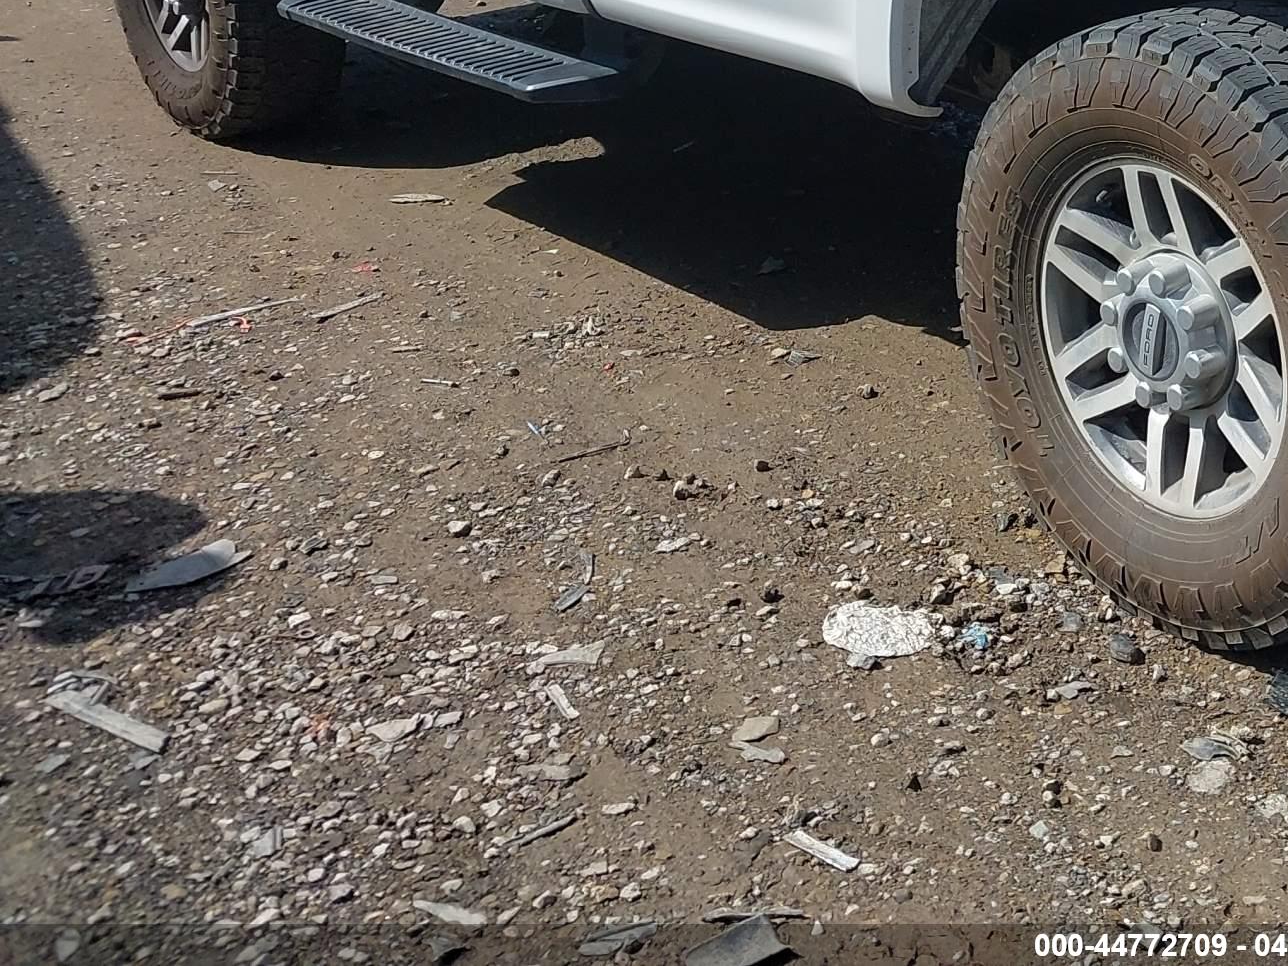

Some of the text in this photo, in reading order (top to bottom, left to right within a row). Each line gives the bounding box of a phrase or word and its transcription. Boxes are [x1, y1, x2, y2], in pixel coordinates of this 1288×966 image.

[991, 185, 1024, 326] TIRES
[997, 332, 1056, 457] TOYO
[1143, 313, 1155, 366] FORD
